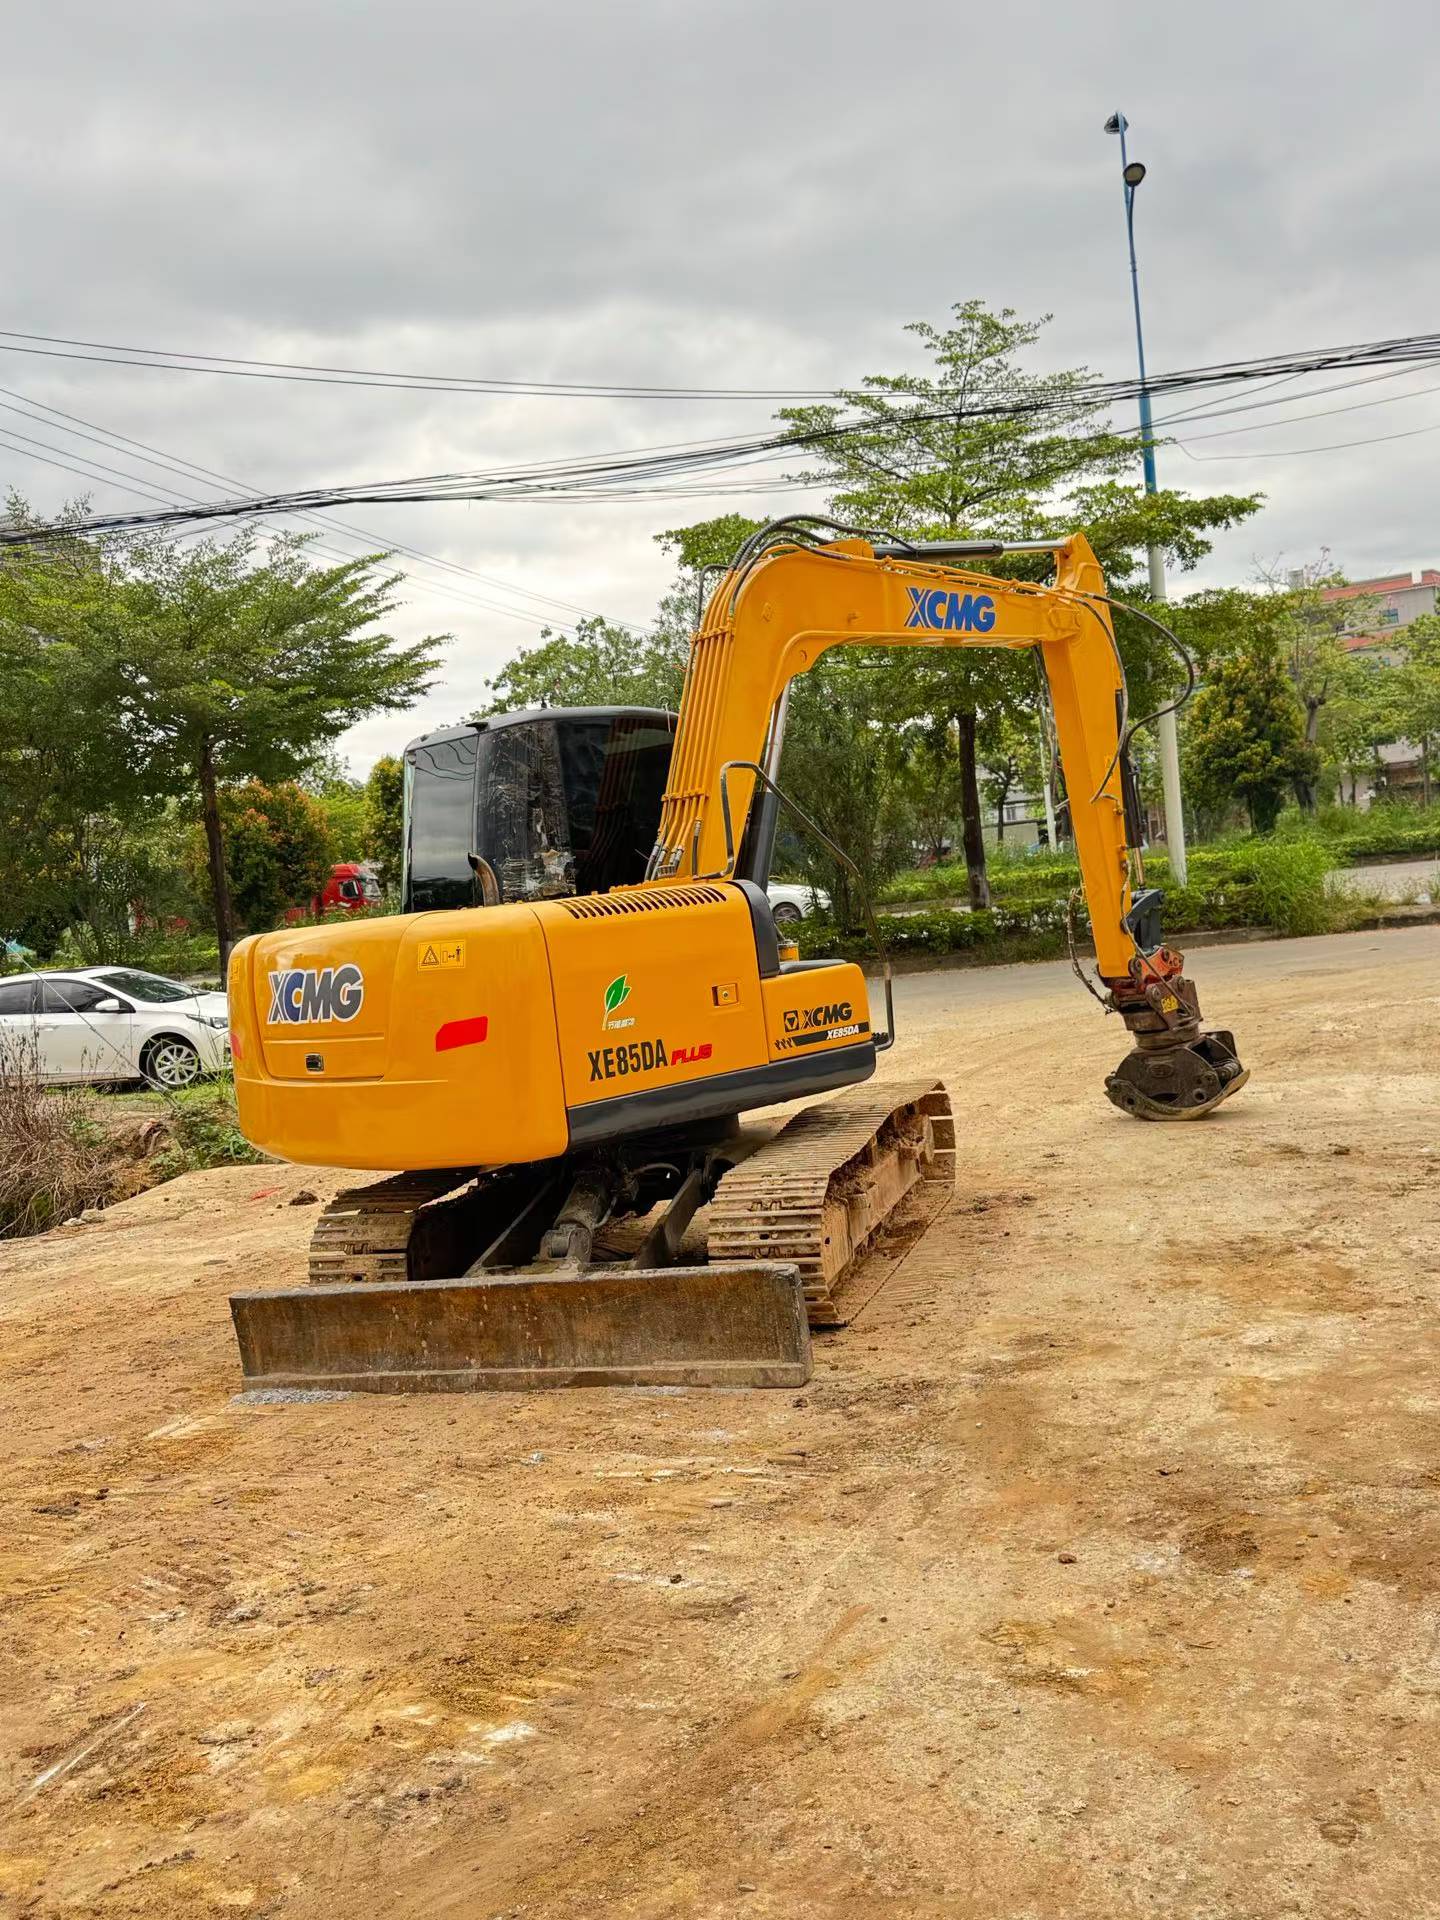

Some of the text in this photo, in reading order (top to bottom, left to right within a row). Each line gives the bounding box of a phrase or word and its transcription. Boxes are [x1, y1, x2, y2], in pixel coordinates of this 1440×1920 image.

[904, 586, 996, 633] XCMG
[267, 964, 364, 1025] XCMG
[802, 1002, 853, 1030] XCMG
[826, 1024, 860, 1041] XE85DA
[587, 1039, 713, 1082] XE85DA PLUS
